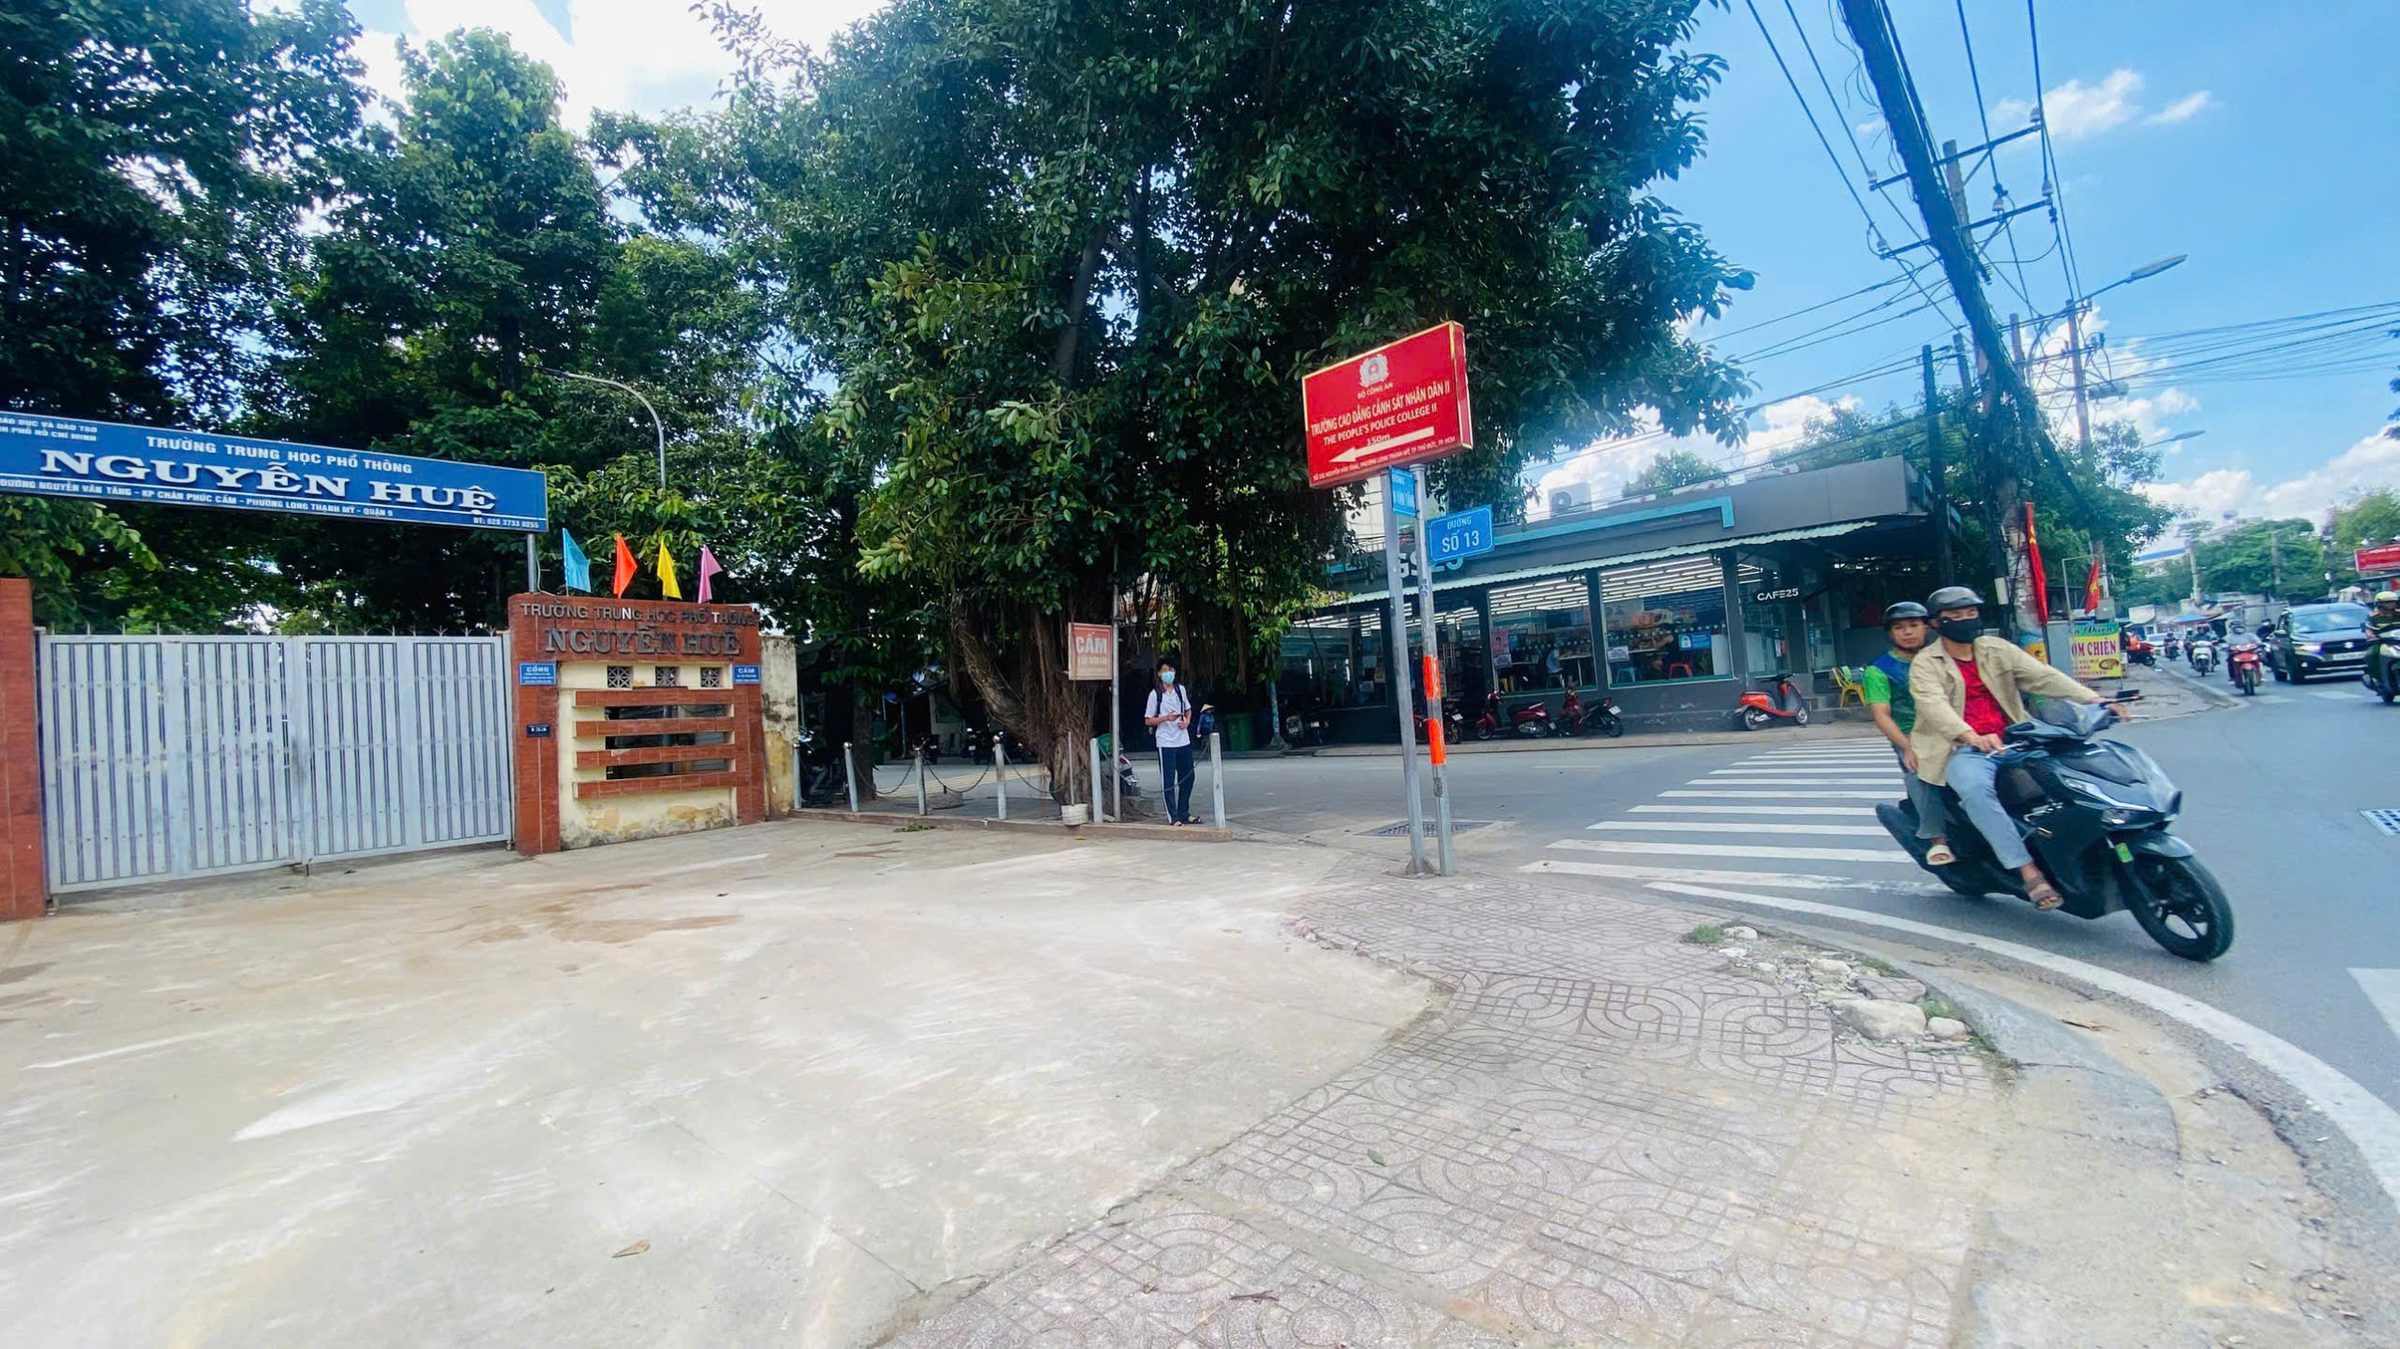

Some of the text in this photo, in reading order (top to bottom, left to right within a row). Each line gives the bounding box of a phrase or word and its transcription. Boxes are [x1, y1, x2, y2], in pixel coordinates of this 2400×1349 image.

[1384, 381, 1394, 390] AN
[1310, 415, 1337, 437] TRƯỜNG
[1338, 413, 1352, 428] CAO
[1352, 404, 1372, 424] ĐẲNG
[1372, 398, 1391, 417] CẢNH
[1391, 392, 1405, 411] SÁT
[1405, 386, 1427, 406] NHÂN
[1427, 382, 1443, 399] DÂN
[1323, 435, 1337, 446] THE
[1338, 425, 1369, 442] PEOPLE'S
[1370, 415, 1396, 433] POLICE
[1396, 405, 1430, 423] COLLEGE
[146, 435, 412, 474] TRƯỜNG TRUNG HỌC PHỔ THÔNG
[38, 480, 79, 493] NGUYỄN
[286, 500, 309, 511] LONG
[40, 449, 497, 516] NGUYỄN HUỆ
[1447, 516, 1472, 530] ĐƯỜNG
[1442, 530, 1480, 553] SỐ 13
[1757, 588, 1799, 601] CAFE25
[521, 602, 588, 618] TRƯỜNG
[594, 607, 641, 621] TRUNG
[648, 609, 677, 623] HỌC
[712, 611, 756, 627] THÔNG
[545, 624, 741, 658] NGUYỄN HUỆ
